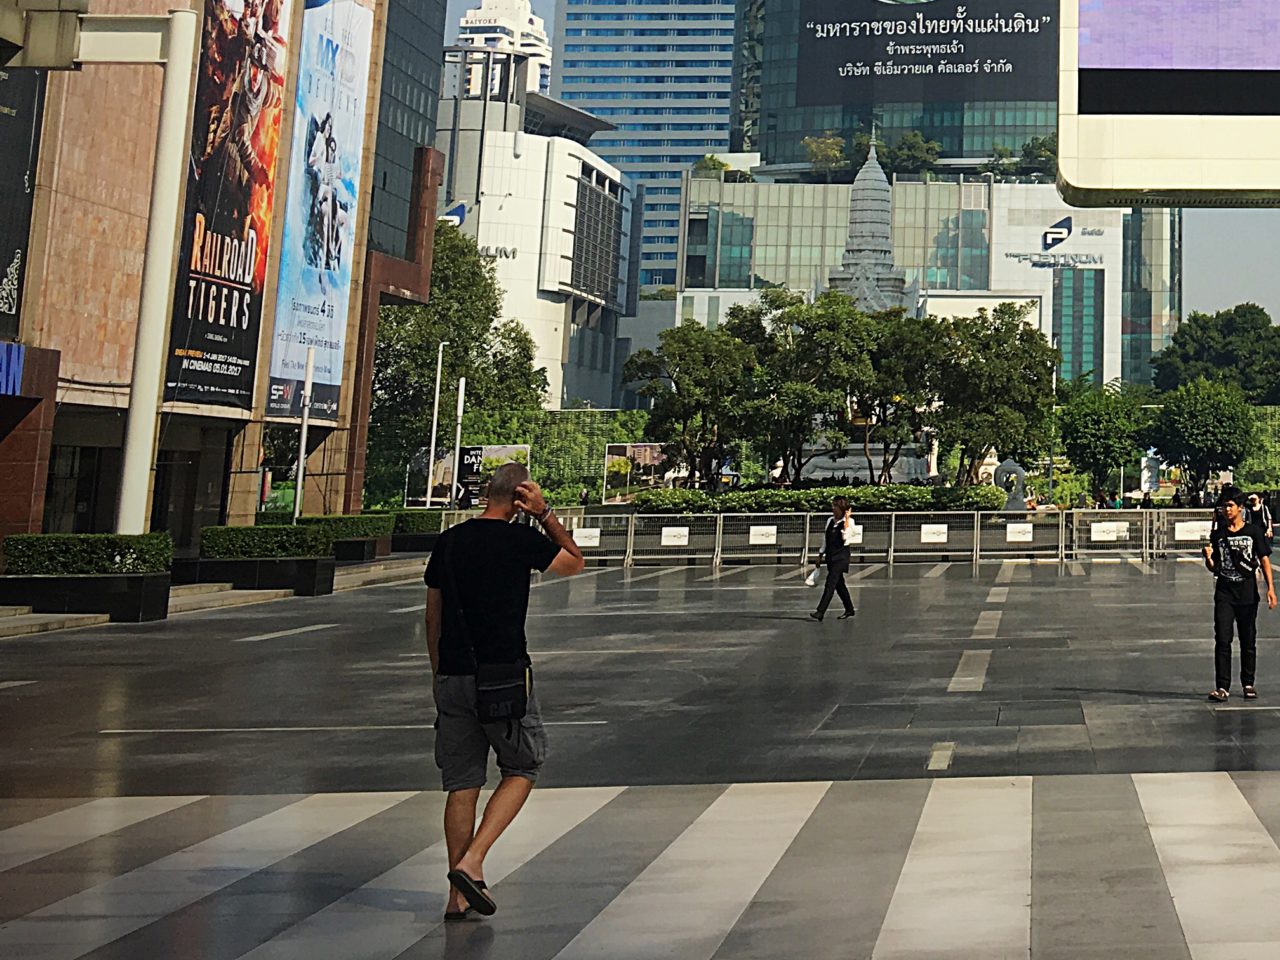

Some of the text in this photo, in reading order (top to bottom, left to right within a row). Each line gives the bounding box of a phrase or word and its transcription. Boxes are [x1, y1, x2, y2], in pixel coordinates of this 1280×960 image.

[806, 6, 1051, 38] “มหาราชของไทยทั้งแผ่นดิน”
[886, 40, 965, 59] ข้าพระพุทธเจ้า
[838, 62, 870, 77] บริษัท
[983, 58, 1013, 73] จำกัด
[190, 213, 257, 284] RAILROAD
[187, 279, 251, 330] TIGERS
[190, 359, 213, 373] CINEMAS
